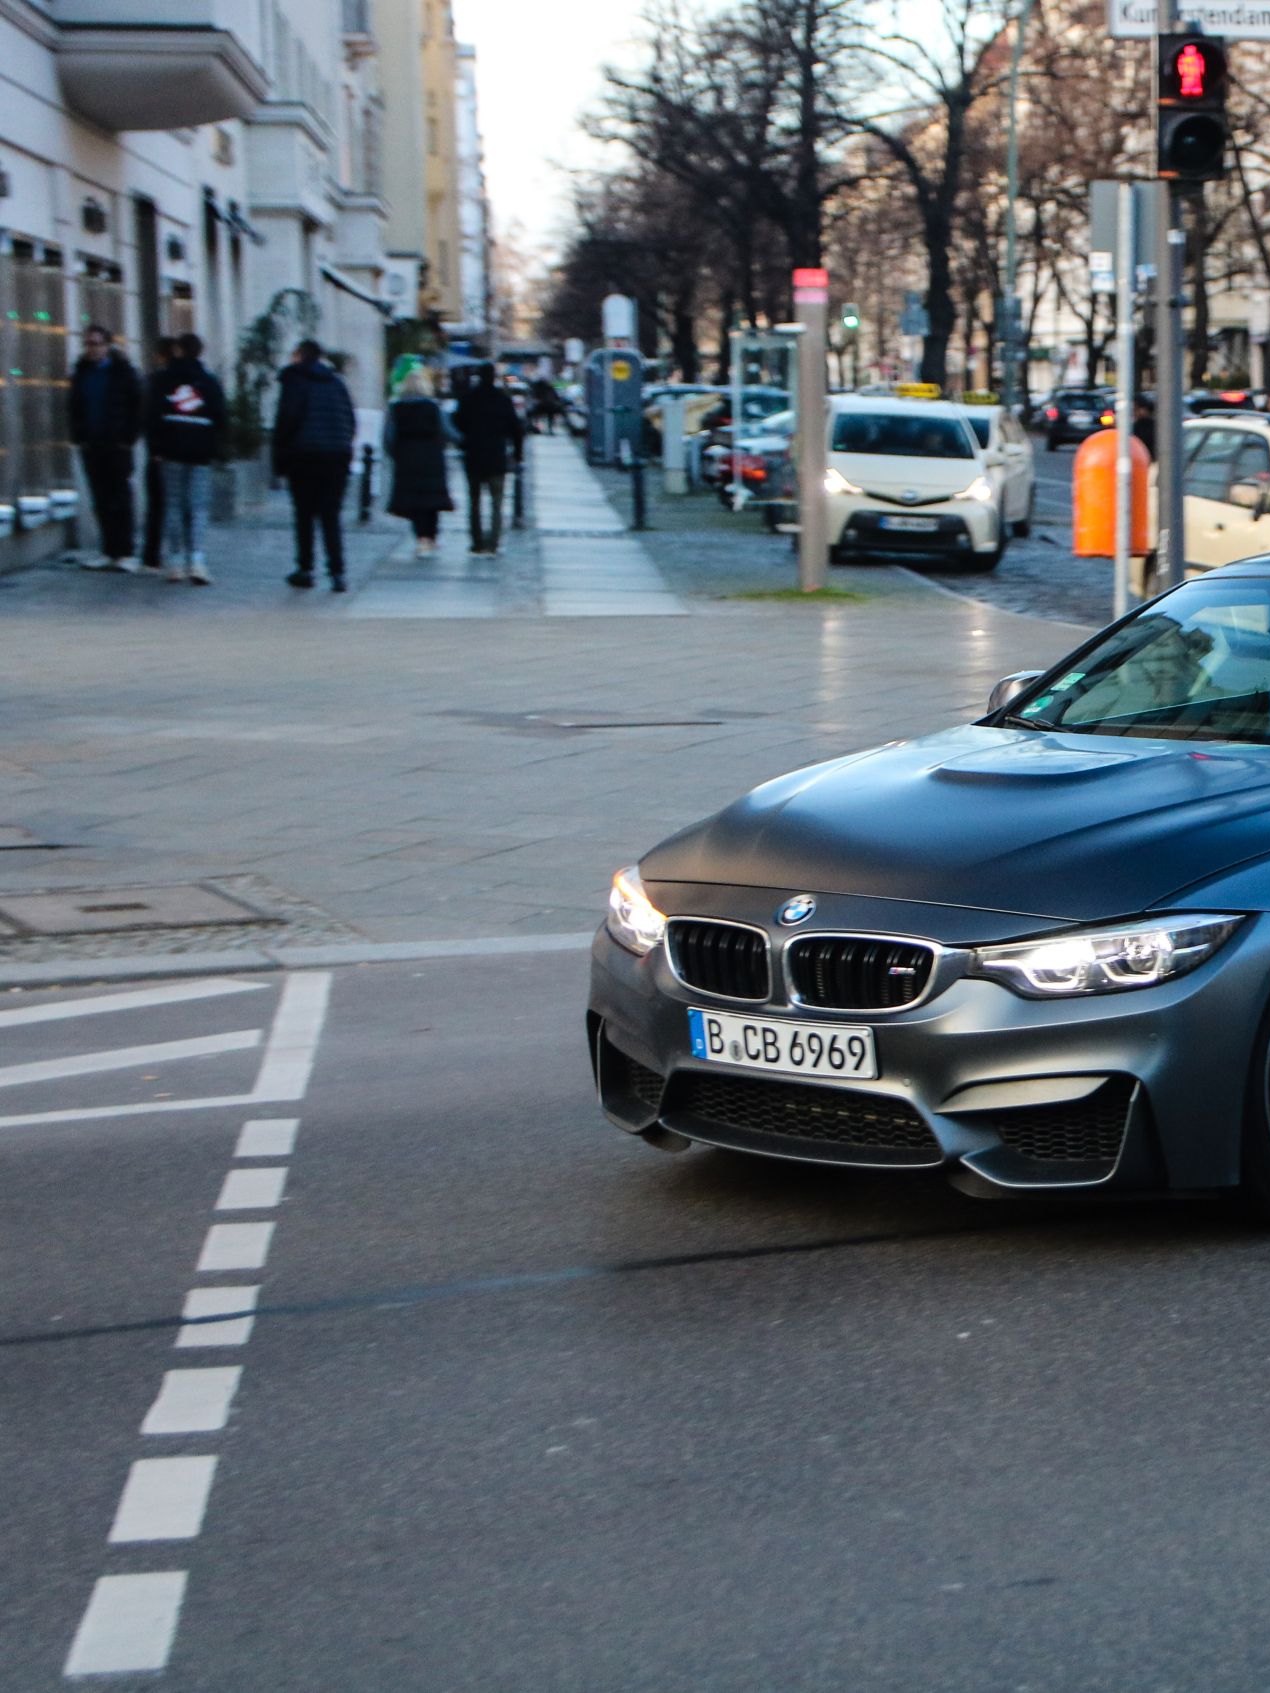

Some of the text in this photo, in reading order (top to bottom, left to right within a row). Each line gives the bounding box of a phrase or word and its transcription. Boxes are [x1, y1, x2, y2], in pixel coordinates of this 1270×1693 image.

[708, 1018, 866, 1070] B CB 6969
